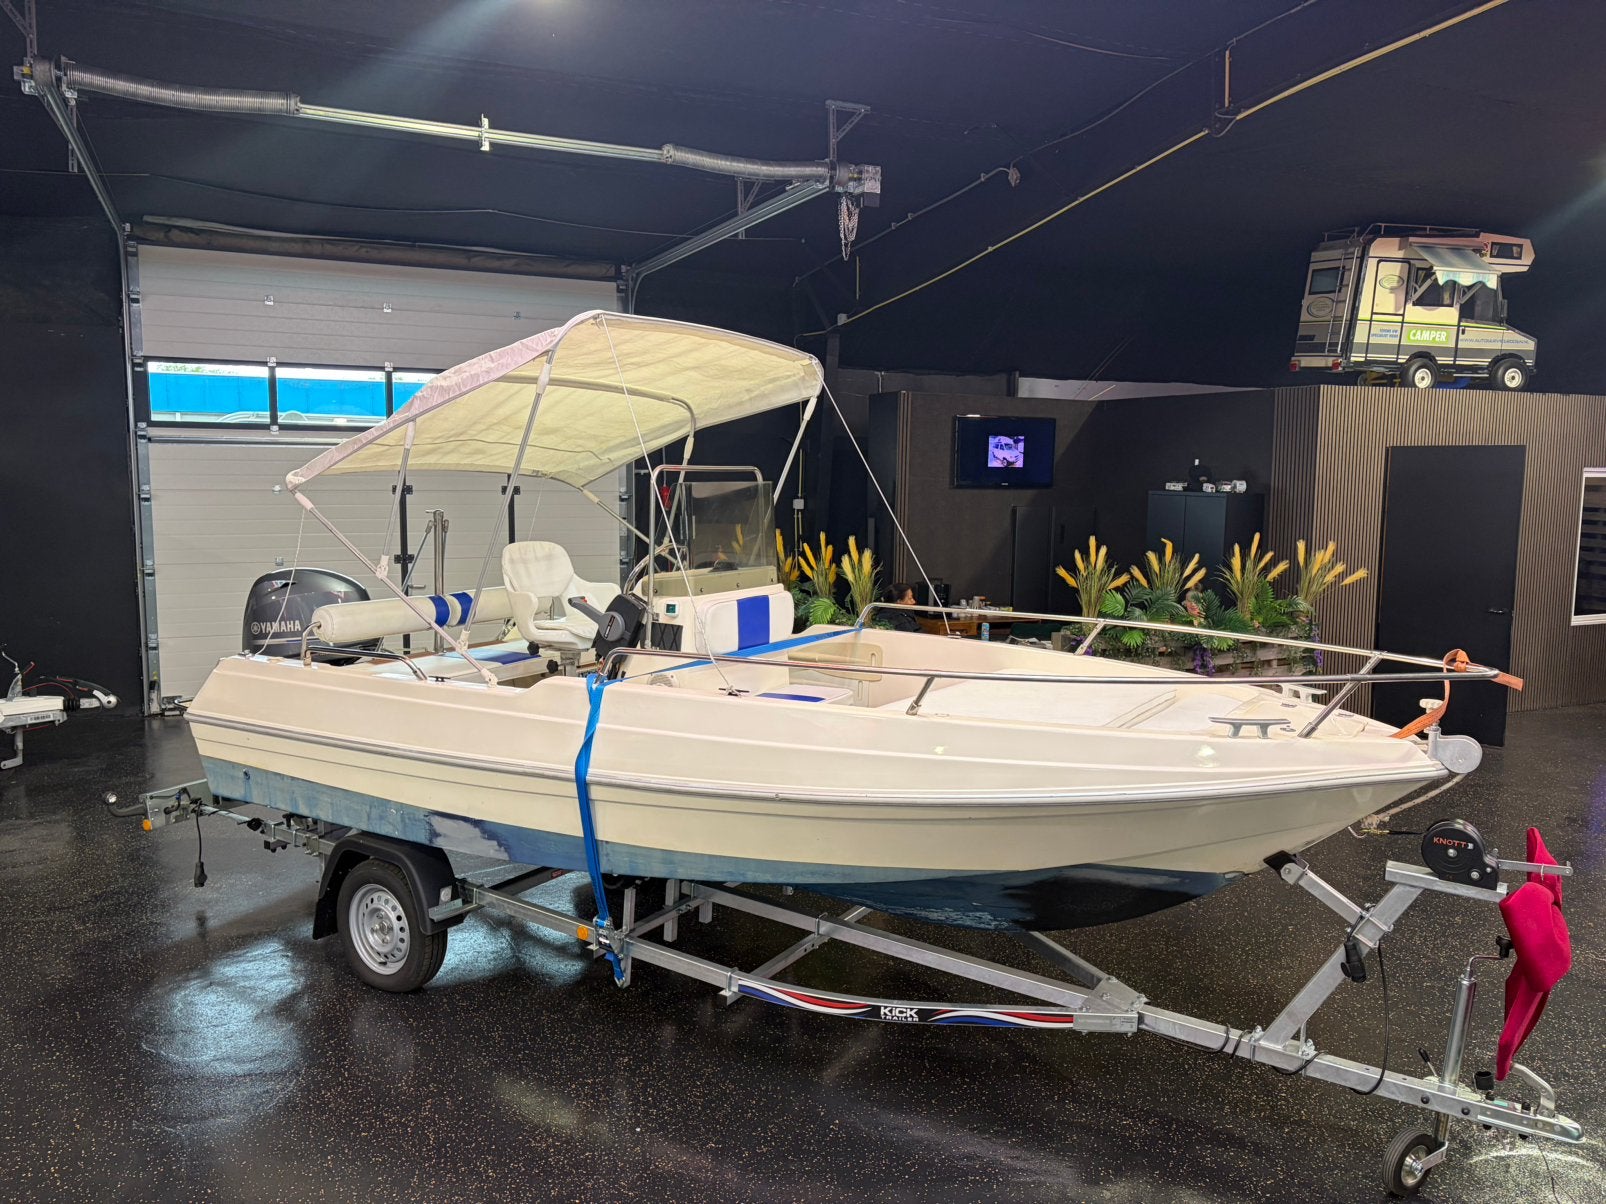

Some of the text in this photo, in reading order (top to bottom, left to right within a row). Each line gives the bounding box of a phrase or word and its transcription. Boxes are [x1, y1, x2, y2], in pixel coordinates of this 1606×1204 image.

[1410, 329, 1447, 342] CAMPER
[260, 620, 301, 634] YAMAHA
[1433, 837, 1467, 848] KNOTT
